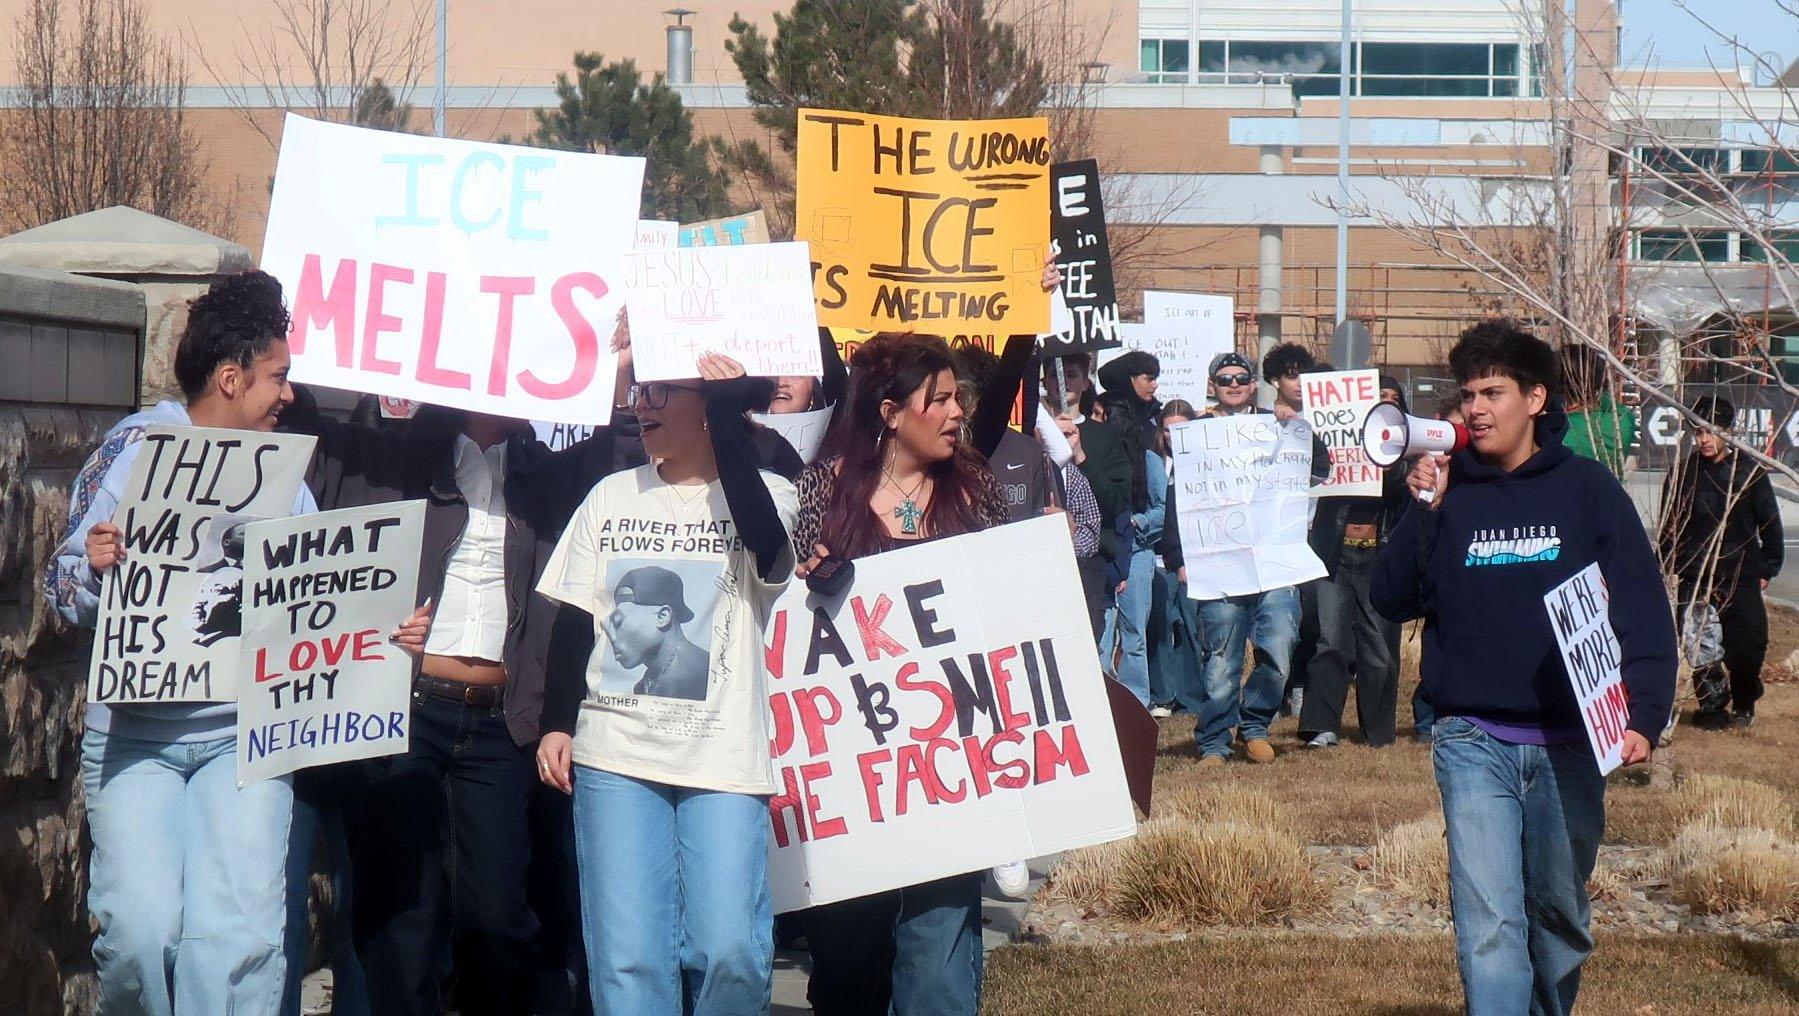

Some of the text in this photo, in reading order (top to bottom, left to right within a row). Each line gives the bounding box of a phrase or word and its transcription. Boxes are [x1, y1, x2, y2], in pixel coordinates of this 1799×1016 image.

[805, 114, 1050, 175] THE WRONG
[375, 150, 556, 241] ICE
[870, 187, 998, 274] ICE
[1076, 229, 1097, 248] in
[625, 251, 711, 288] JESUS
[664, 288, 722, 317] LOVE
[872, 284, 1010, 323] MELTING
[289, 253, 609, 400] MELTS
[725, 331, 802, 356] deport
[1307, 376, 1374, 408] HATE
[1175, 427, 1190, 454] I
[1204, 421, 1271, 450] Like
[1313, 409, 1355, 428] Does
[1427, 429, 1443, 438] PYLE
[1318, 430, 1338, 447] OT
[141, 434, 279, 513] THIS
[1197, 461, 1212, 473] IN
[1220, 456, 1248, 471] MY
[1003, 484, 1026, 505] GO
[1185, 481, 1208, 495] NOT
[124, 507, 211, 561] WAS
[263, 517, 400, 571] WHAT
[600, 536, 744, 553] FLOWS FOREVE
[601, 519, 730, 537] A RIVER THAT
[1473, 526, 1557, 541] JUAN DIEGO
[1466, 537, 1561, 566] SWIMMING
[107, 560, 190, 611] NOT
[253, 565, 397, 609] HAPPENED
[287, 600, 336, 635] TO
[1551, 572, 1602, 644] WE'RE
[103, 614, 168, 660] HIS
[255, 629, 386, 682] LOVE
[1568, 623, 1621, 697] MORE
[96, 660, 210, 701] DREAM
[269, 669, 339, 710] THY
[597, 695, 639, 707] MOTHER
[248, 712, 405, 763] NEIGHBOR
[769, 725, 1090, 847] HE FACISM
